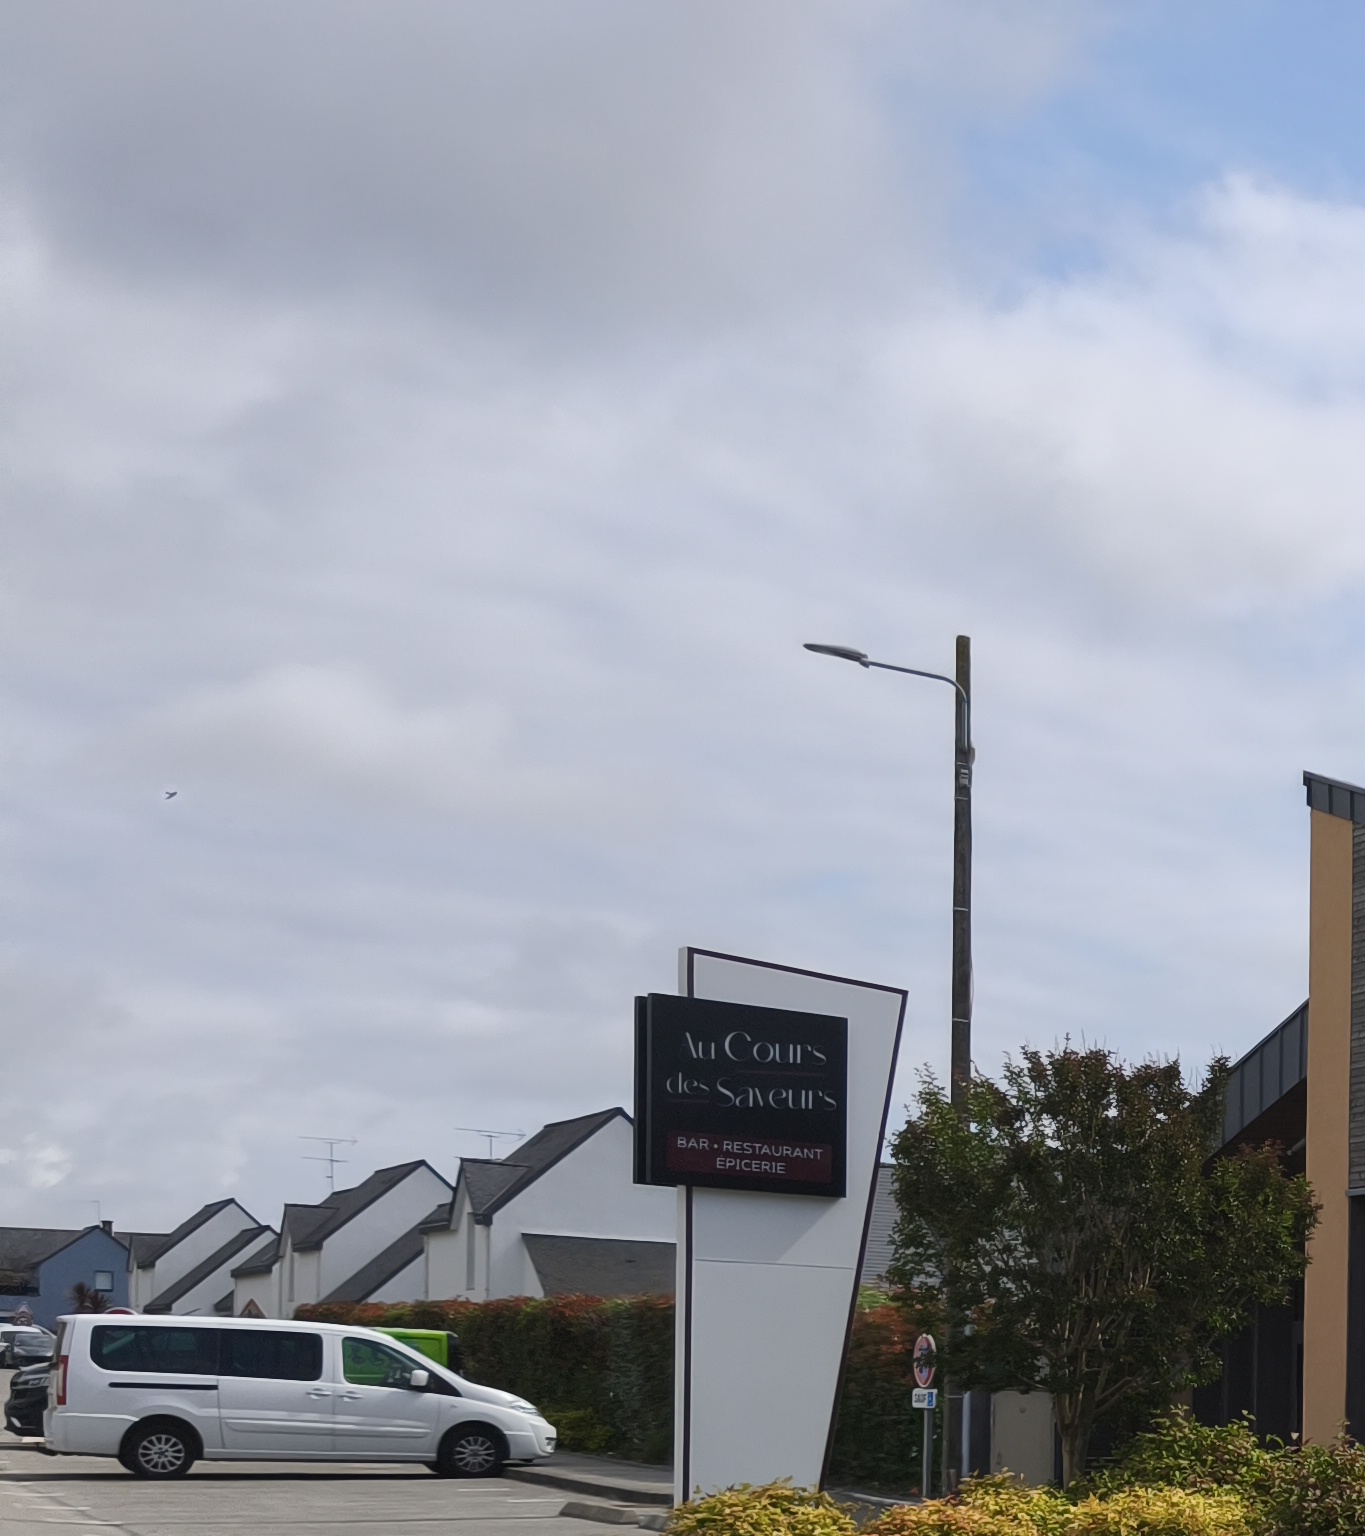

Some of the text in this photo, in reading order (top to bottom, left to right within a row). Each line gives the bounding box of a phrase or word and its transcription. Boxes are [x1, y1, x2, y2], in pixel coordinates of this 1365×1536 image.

[681, 1031, 827, 1066] Au Cours
[666, 1071, 837, 1111] des Saveurs
[677, 1136, 824, 1160] BAR RESTAURANT
[716, 1155, 787, 1174] ÉPICERIE
